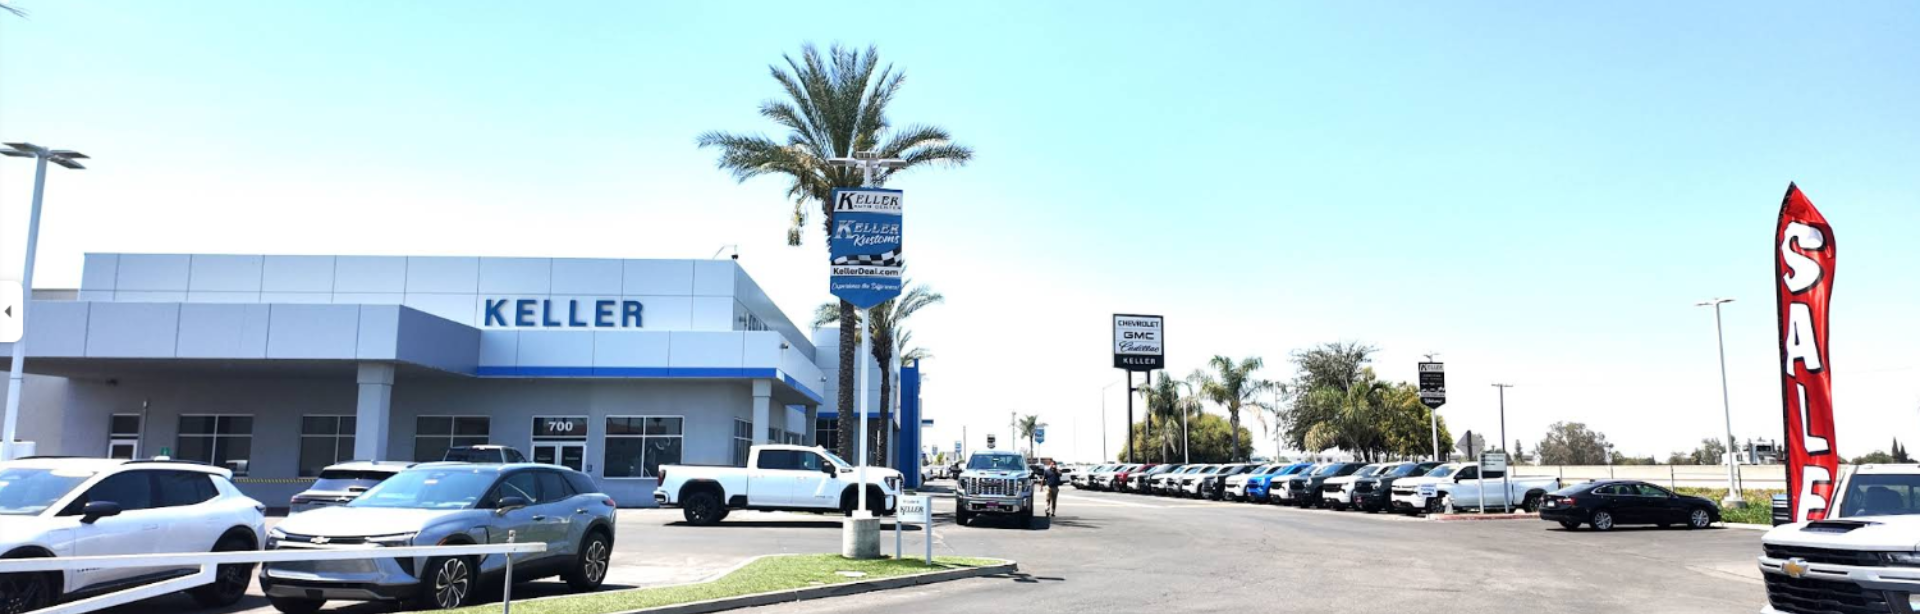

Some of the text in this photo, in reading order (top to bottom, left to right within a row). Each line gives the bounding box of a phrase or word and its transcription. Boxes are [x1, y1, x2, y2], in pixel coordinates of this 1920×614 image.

[838, 192, 899, 210] KELLER
[834, 220, 900, 239] KELLER
[853, 234, 900, 246] Kustoms
[833, 267, 899, 276] KellerDeal.com
[484, 299, 644, 328] KELLER
[1118, 320, 1159, 328] CHEVROLET
[1123, 331, 1155, 340] GMC
[1118, 340, 1160, 352] Cadillac
[1122, 357, 1156, 365] KELLER
[1782, 221, 1831, 523] SALE
[548, 421, 573, 432] 700
[900, 506, 924, 515] KELLER
